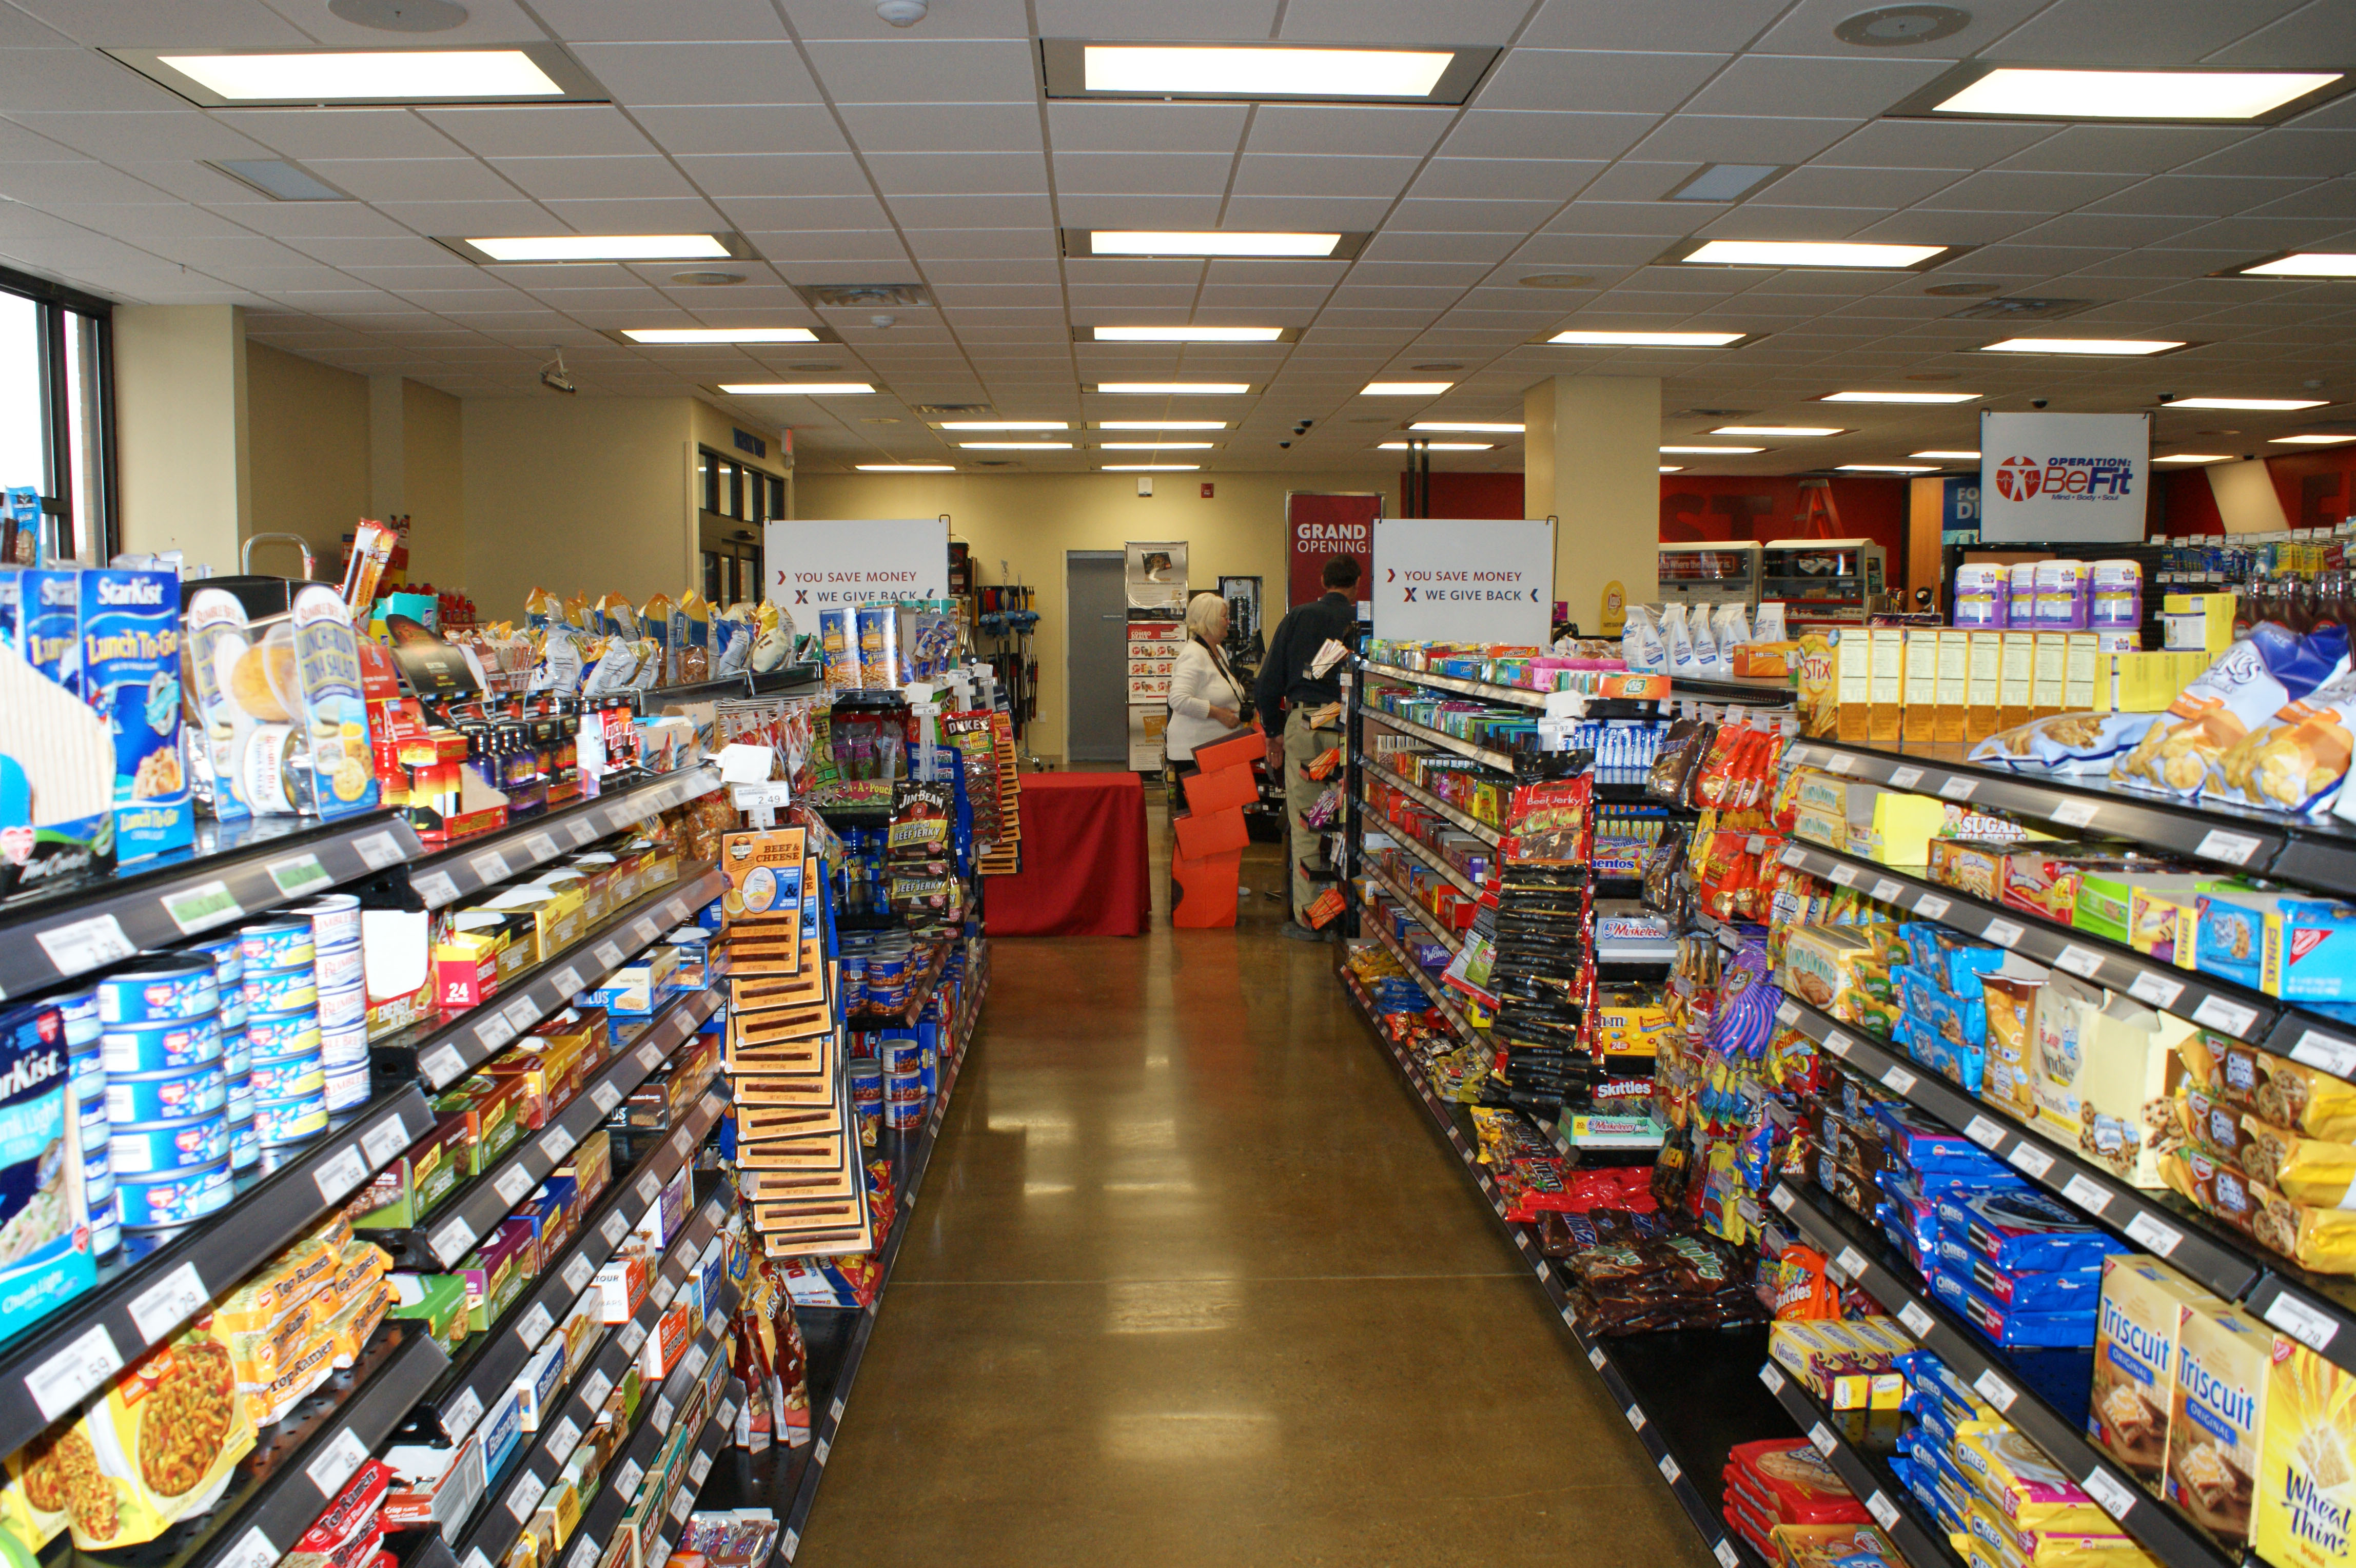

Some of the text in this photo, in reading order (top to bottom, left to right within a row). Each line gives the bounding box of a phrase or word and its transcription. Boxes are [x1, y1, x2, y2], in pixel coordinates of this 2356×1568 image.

[2048, 458, 2131, 466] OPERATION:
[2041, 467, 2133, 495] BeFit
[1298, 524, 1366, 539] GRAND
[1298, 540, 1366, 553] OPENING
[1670, 560, 1689, 569] Where
[1690, 560, 1701, 569] the
[795, 571, 917, 582] YOU SAVE MONEY
[1404, 571, 1522, 581] YOU SAVE MONEY
[97, 576, 164, 605] StarKist
[817, 591, 916, 602] WE GIVE BACK
[1425, 590, 1521, 601] WE GIVE BACK
[825, 628, 841, 637] PLANTERS
[863, 628, 879, 637] PLANTERS
[87, 629, 140, 665] Lunch
[948, 717, 989, 734] DUKE'S
[758, 795, 781, 805] 2.49
[899, 790, 944, 809] JIM BEAM
[1527, 796, 1581, 807] Beef Jerky
[120, 809, 151, 832] Lunch
[1542, 810, 1579, 832] Lime
[1961, 816, 2023, 834] SUGAR
[894, 828, 941, 841] BEEF JERKY
[756, 852, 800, 863] CHEESE
[763, 844, 793, 853] BEEF
[897, 880, 944, 893] BEEF JERKY
[1605, 925, 1613, 935] 3
[448, 982, 468, 998] 24
[1642, 1015, 1664, 1027] Sharing
[1597, 1081, 1651, 1097] Skittles
[1595, 1120, 1635, 1132] Musketeers
[1939, 1204, 1964, 1222] OREO
[1941, 1241, 1968, 1261] OREO
[333, 1252, 379, 1296] Top Ramen
[273, 1278, 294, 1299] Top
[1775, 1284, 1812, 1308] Skittles
[1936, 1276, 1962, 1295] OREO
[2, 1285, 37, 1314] Chunk
[168, 1290, 199, 1322] 1.29
[664, 1325, 686, 1363] DETOUR
[2103, 1297, 2170, 1373] Triscuit
[2293, 1323, 2322, 1345] 1.79
[269, 1339, 334, 1393] Top Ramen
[1775, 1341, 1804, 1370] Newtons
[2111, 1348, 2148, 1382] ORIGINAL
[75, 1357, 112, 1390] 1.59
[538, 1360, 561, 1400] Balance
[711, 1365, 723, 1401] CLIF
[1875, 1381, 1900, 1390] Newtons
[1916, 1374, 1940, 1397] OREO
[2178, 1347, 2255, 1432] Triscuit
[461, 1403, 480, 1425] 1.20
[1923, 1413, 1945, 1437] OREO
[2189, 1403, 2230, 1439] ORIGINAL
[488, 1407, 516, 1457] Balance
[690, 1411, 702, 1444] CLIF
[1913, 1444, 1937, 1469] OREO
[1956, 1442, 1987, 1472] OREO
[669, 1452, 682, 1492] CLIF
[318, 1465, 378, 1529] Top Ramen
[1912, 1481, 1936, 1507] OREO
[2100, 1492, 2122, 1513] 3.49
[2286, 1464, 2351, 1535] Wheat
[645, 1504, 660, 1543] CLIF
[1971, 1517, 2001, 1549] OREO
[2281, 1502, 2350, 1558] Thins
[583, 1545, 599, 1566] 1.25
